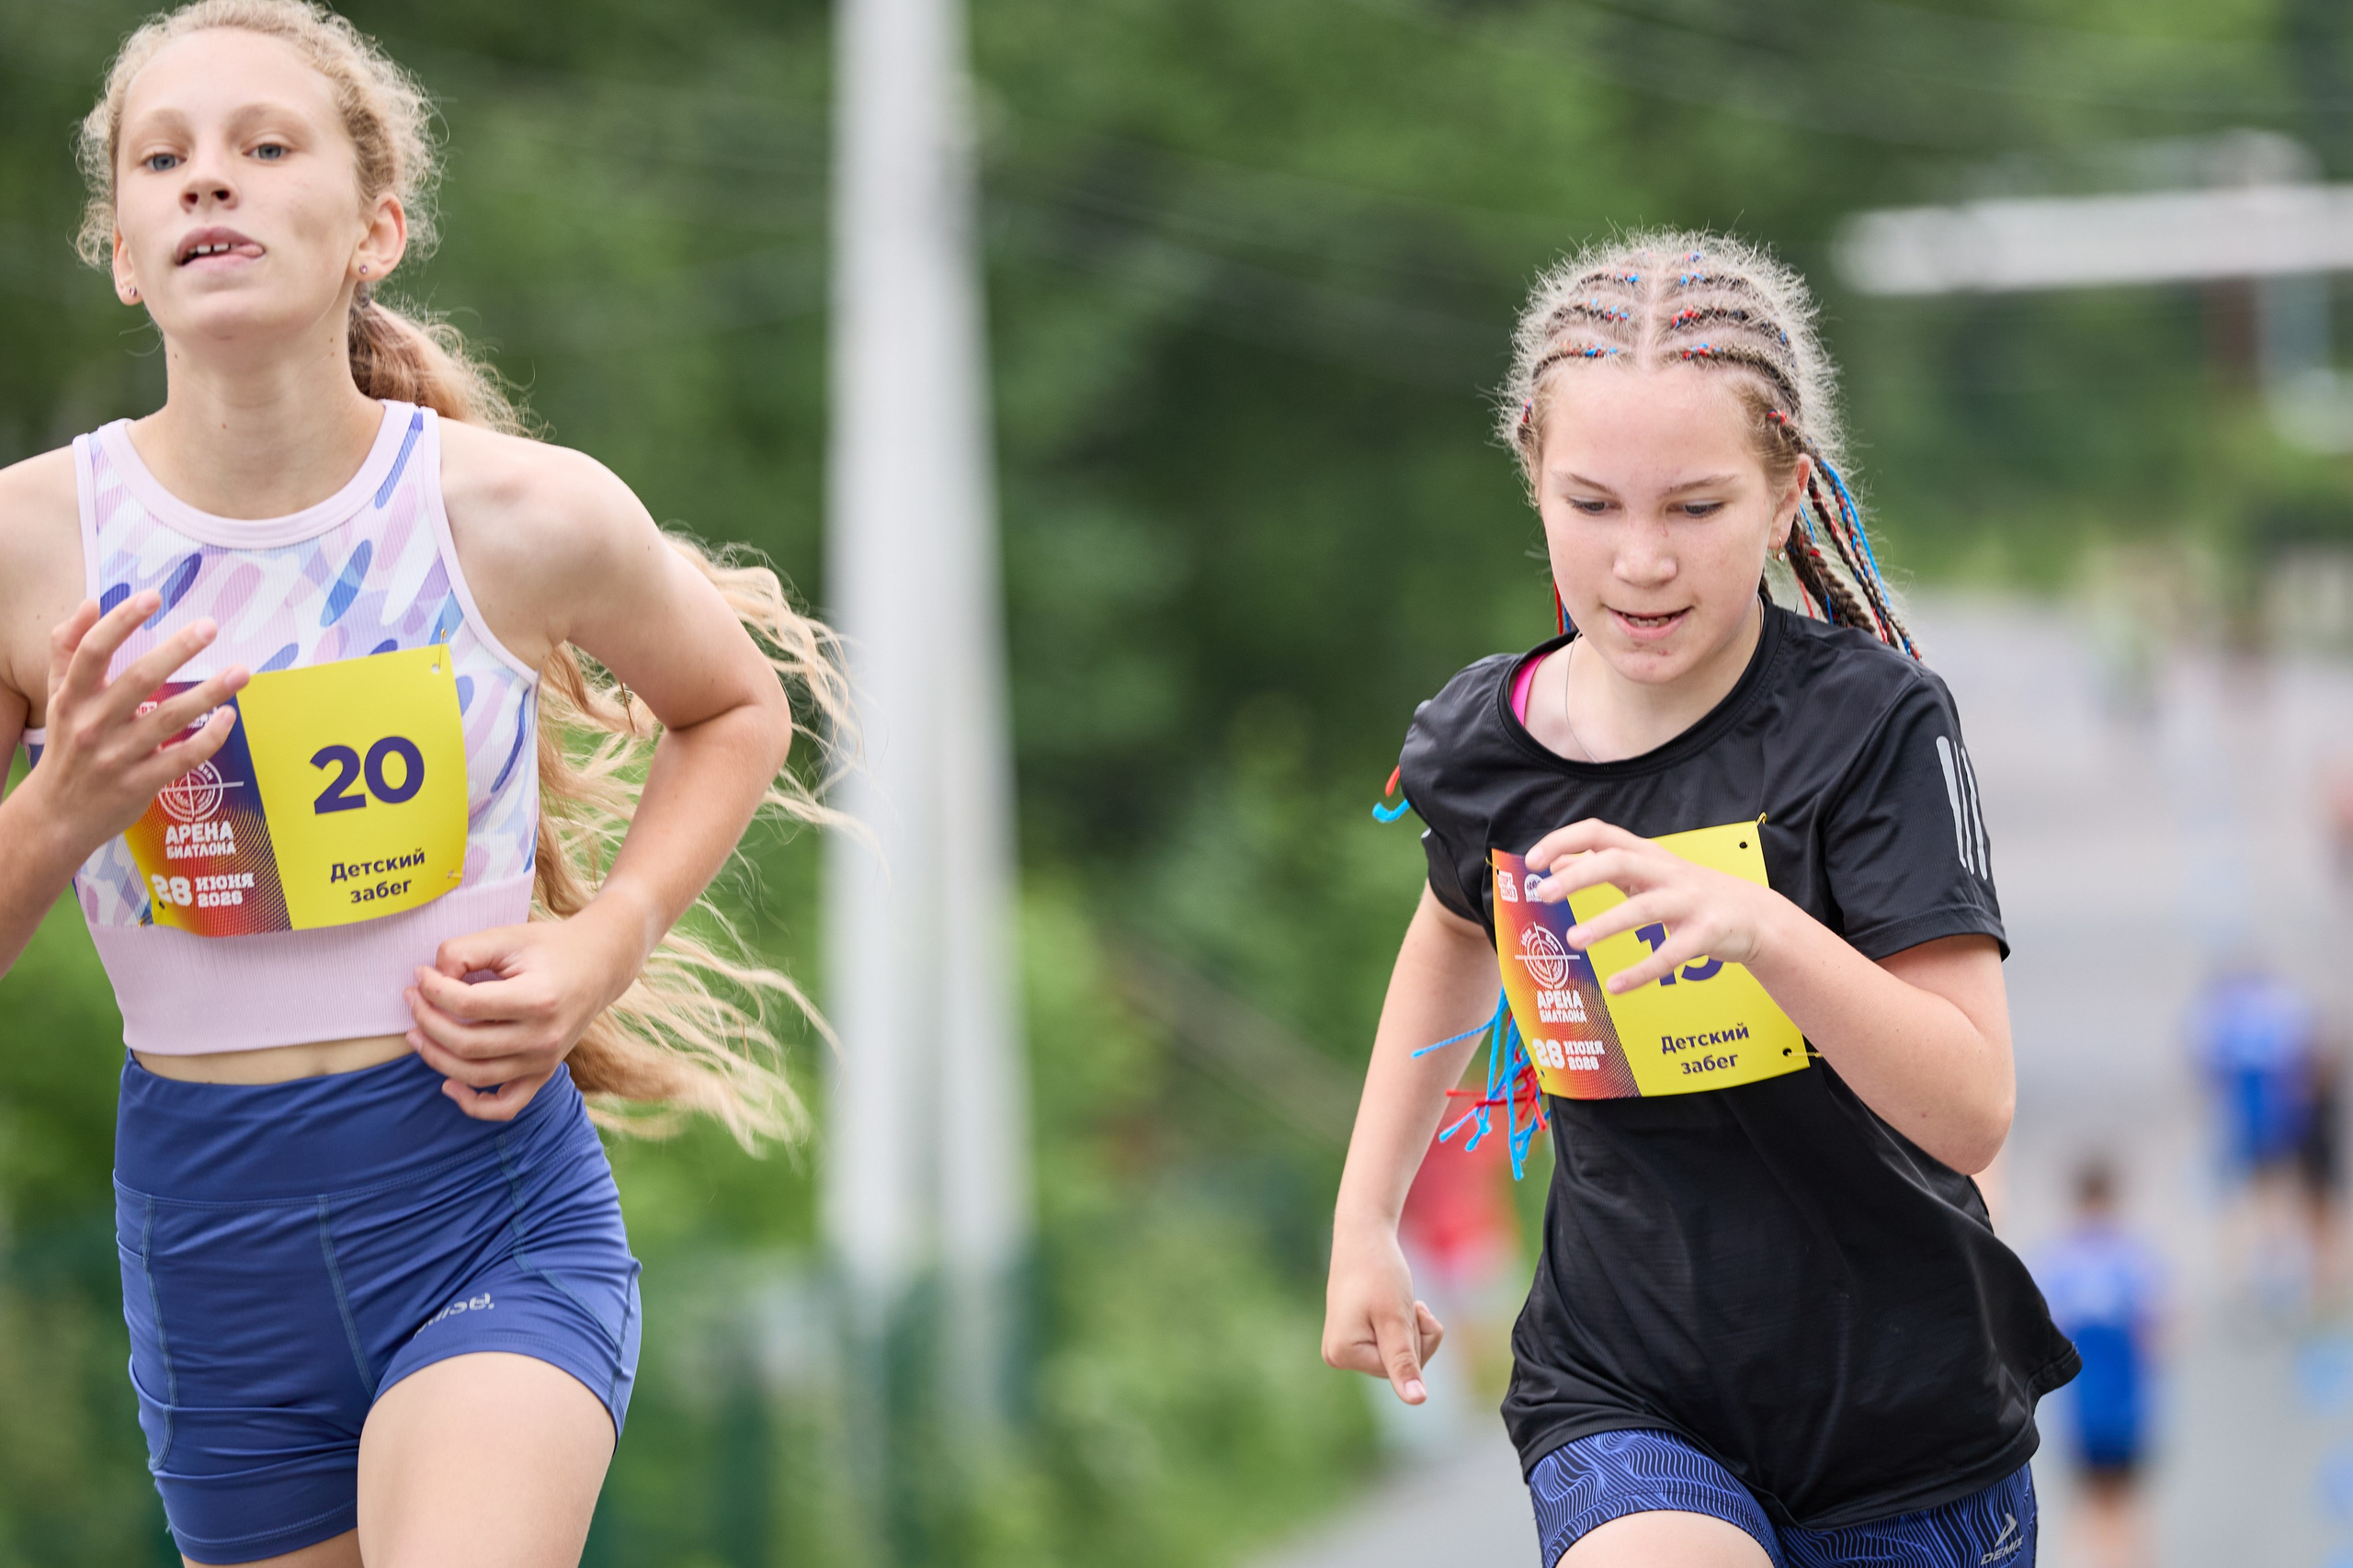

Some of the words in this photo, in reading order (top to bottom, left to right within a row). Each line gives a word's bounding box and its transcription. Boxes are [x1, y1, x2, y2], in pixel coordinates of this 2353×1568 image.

[309, 735, 426, 815] 20
[165, 820, 234, 846] АРЕНА
[166, 840, 236, 859] БИАТЛОНА
[331, 847, 425, 883] Детский
[151, 873, 193, 906] 28
[195, 872, 255, 892] ИЮНЯ
[350, 880, 412, 903] забег
[1537, 989, 1584, 1009] АРЕНА
[1539, 1009, 1587, 1023] БИАТЛОНА
[1661, 1022, 1749, 1054] Детский
[1532, 1038, 1565, 1069] 28
[1563, 1040, 1606, 1055] ИЮНЯ
[1681, 1054, 1738, 1074] забег
[1980, 1534, 2024, 1565] DEMIX
